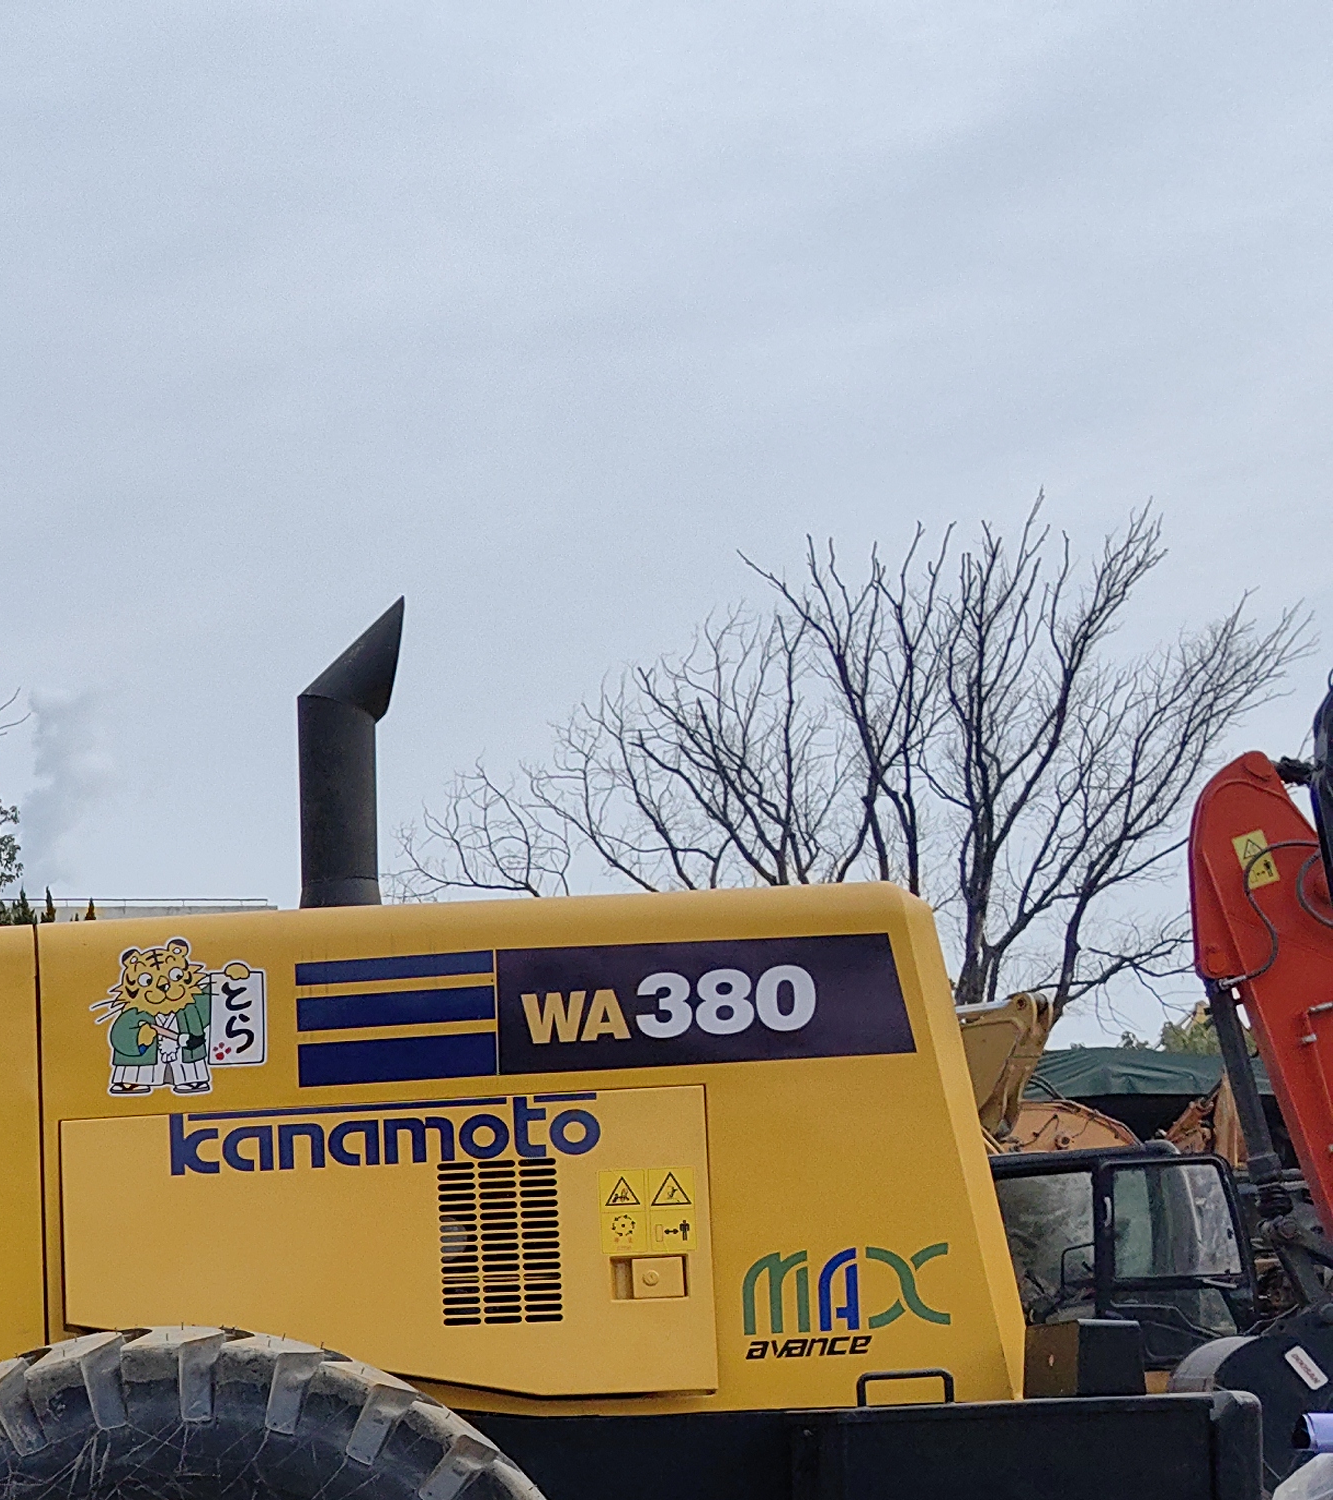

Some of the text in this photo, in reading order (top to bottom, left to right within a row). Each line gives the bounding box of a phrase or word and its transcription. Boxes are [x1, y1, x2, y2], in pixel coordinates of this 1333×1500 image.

[220, 981, 255, 1054] とら
[170, 1093, 601, 1176] kanamoto
[741, 1242, 951, 1336] MAX
[745, 1335, 873, 1360] avance
